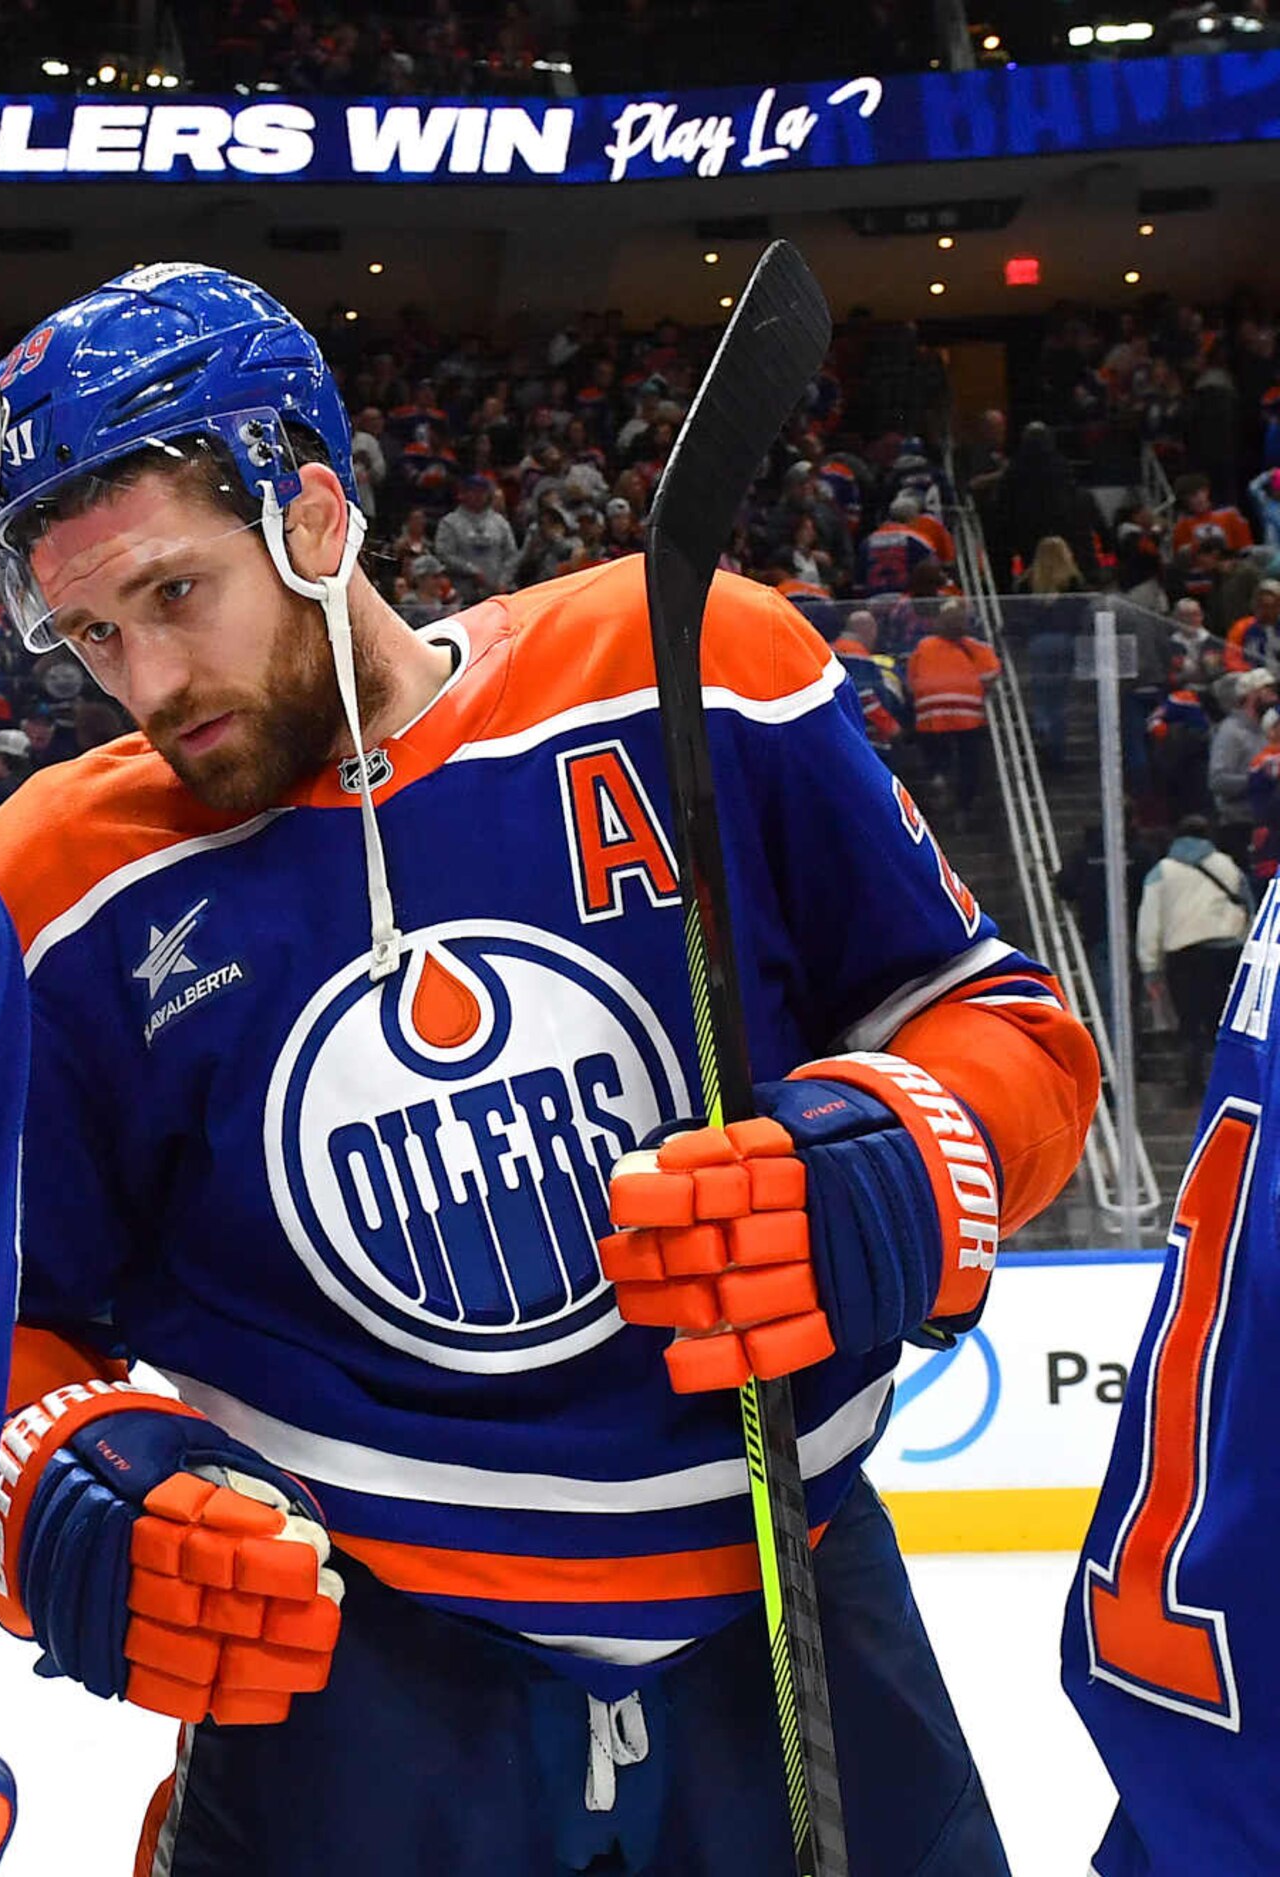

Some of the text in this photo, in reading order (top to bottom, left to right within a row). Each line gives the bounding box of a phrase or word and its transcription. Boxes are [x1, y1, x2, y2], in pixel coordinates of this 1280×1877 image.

[345, 105, 575, 175] WIN
[604, 101, 737, 183] Play
[555, 738, 683, 925] A
[327, 1051, 641, 1326] OILERS
[1082, 1094, 1264, 1733] 1
